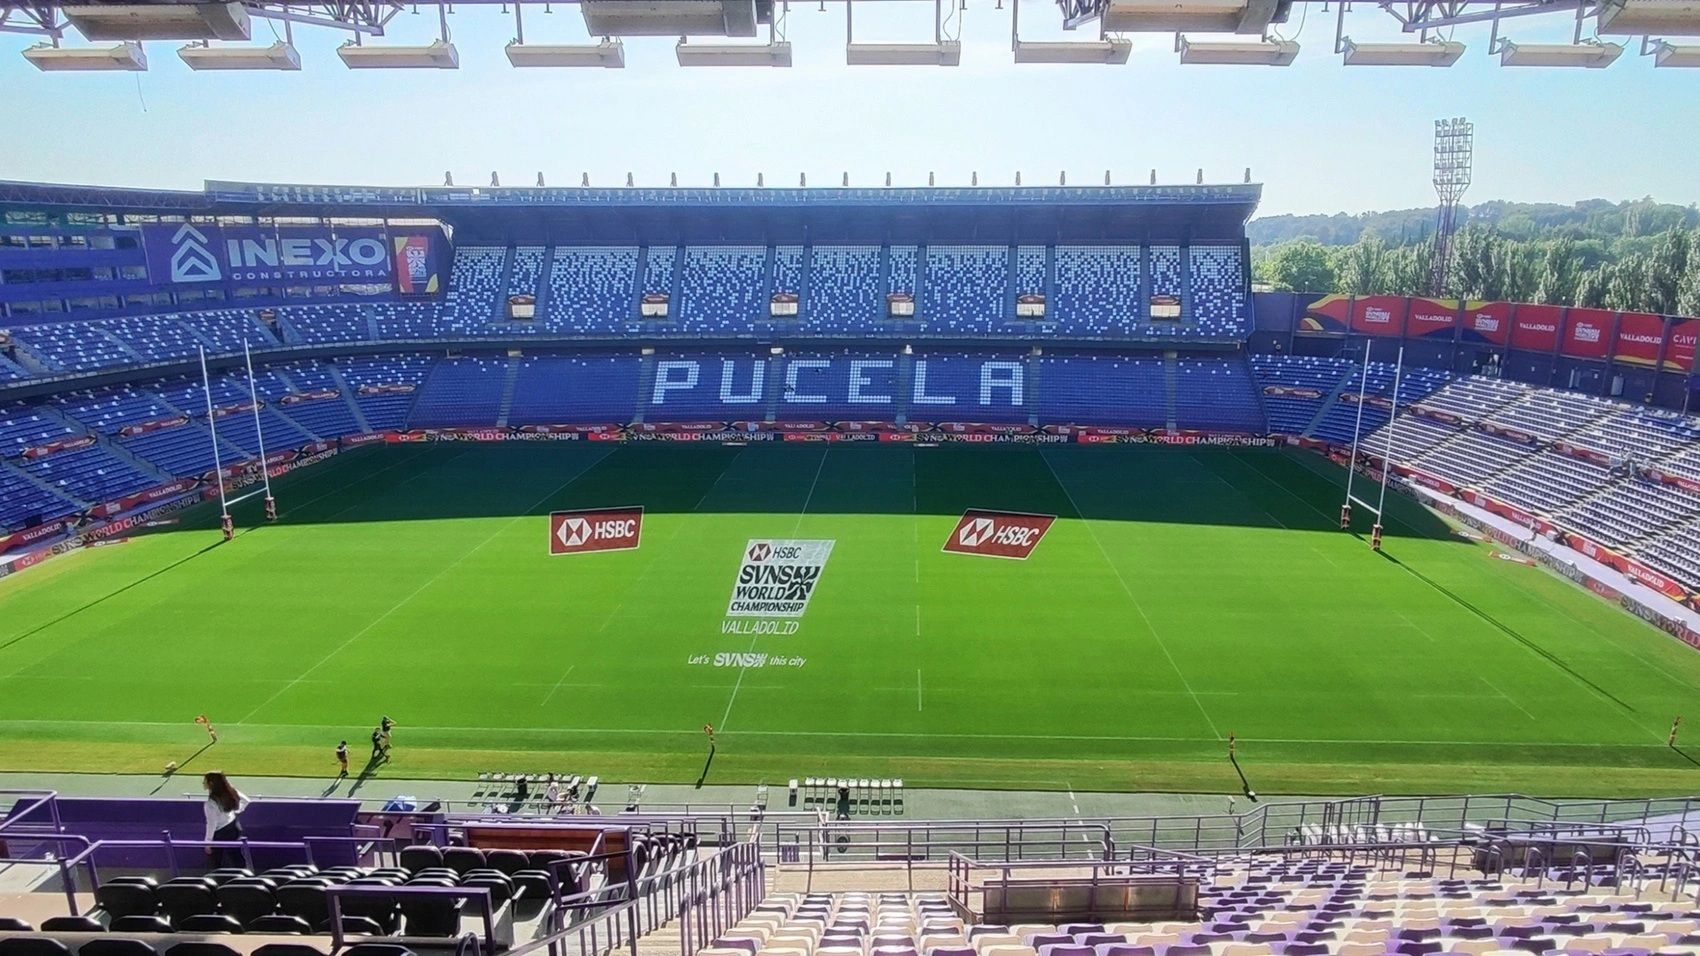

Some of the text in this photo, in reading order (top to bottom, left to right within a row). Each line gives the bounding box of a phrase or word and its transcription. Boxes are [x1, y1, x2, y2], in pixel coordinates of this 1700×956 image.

[227, 238, 386, 267] INEXO
[233, 269, 386, 281] CONSTRUCTORA
[1415, 313, 1452, 322] VALLADOLID
[1519, 322, 1555, 332] VALLADOLID
[1620, 333, 1662, 344] VALLADOLID
[652, 361, 1023, 405] PUCELA
[692, 432, 766, 441] CHAMPIONSHIP
[123, 497, 195, 529] CHAMPIONSHIP
[594, 519, 636, 539] HSBC
[991, 525, 1040, 547] HSBC
[772, 547, 801, 559] HSBC
[740, 564, 793, 585] SVNS
[736, 586, 786, 600] WORLD
[731, 601, 804, 612] CHAMPIONSHIP
[721, 620, 800, 635] VALLADOLID
[688, 654, 710, 664] Let's
[770, 656, 787, 665] this
[788, 656, 807, 668] city
